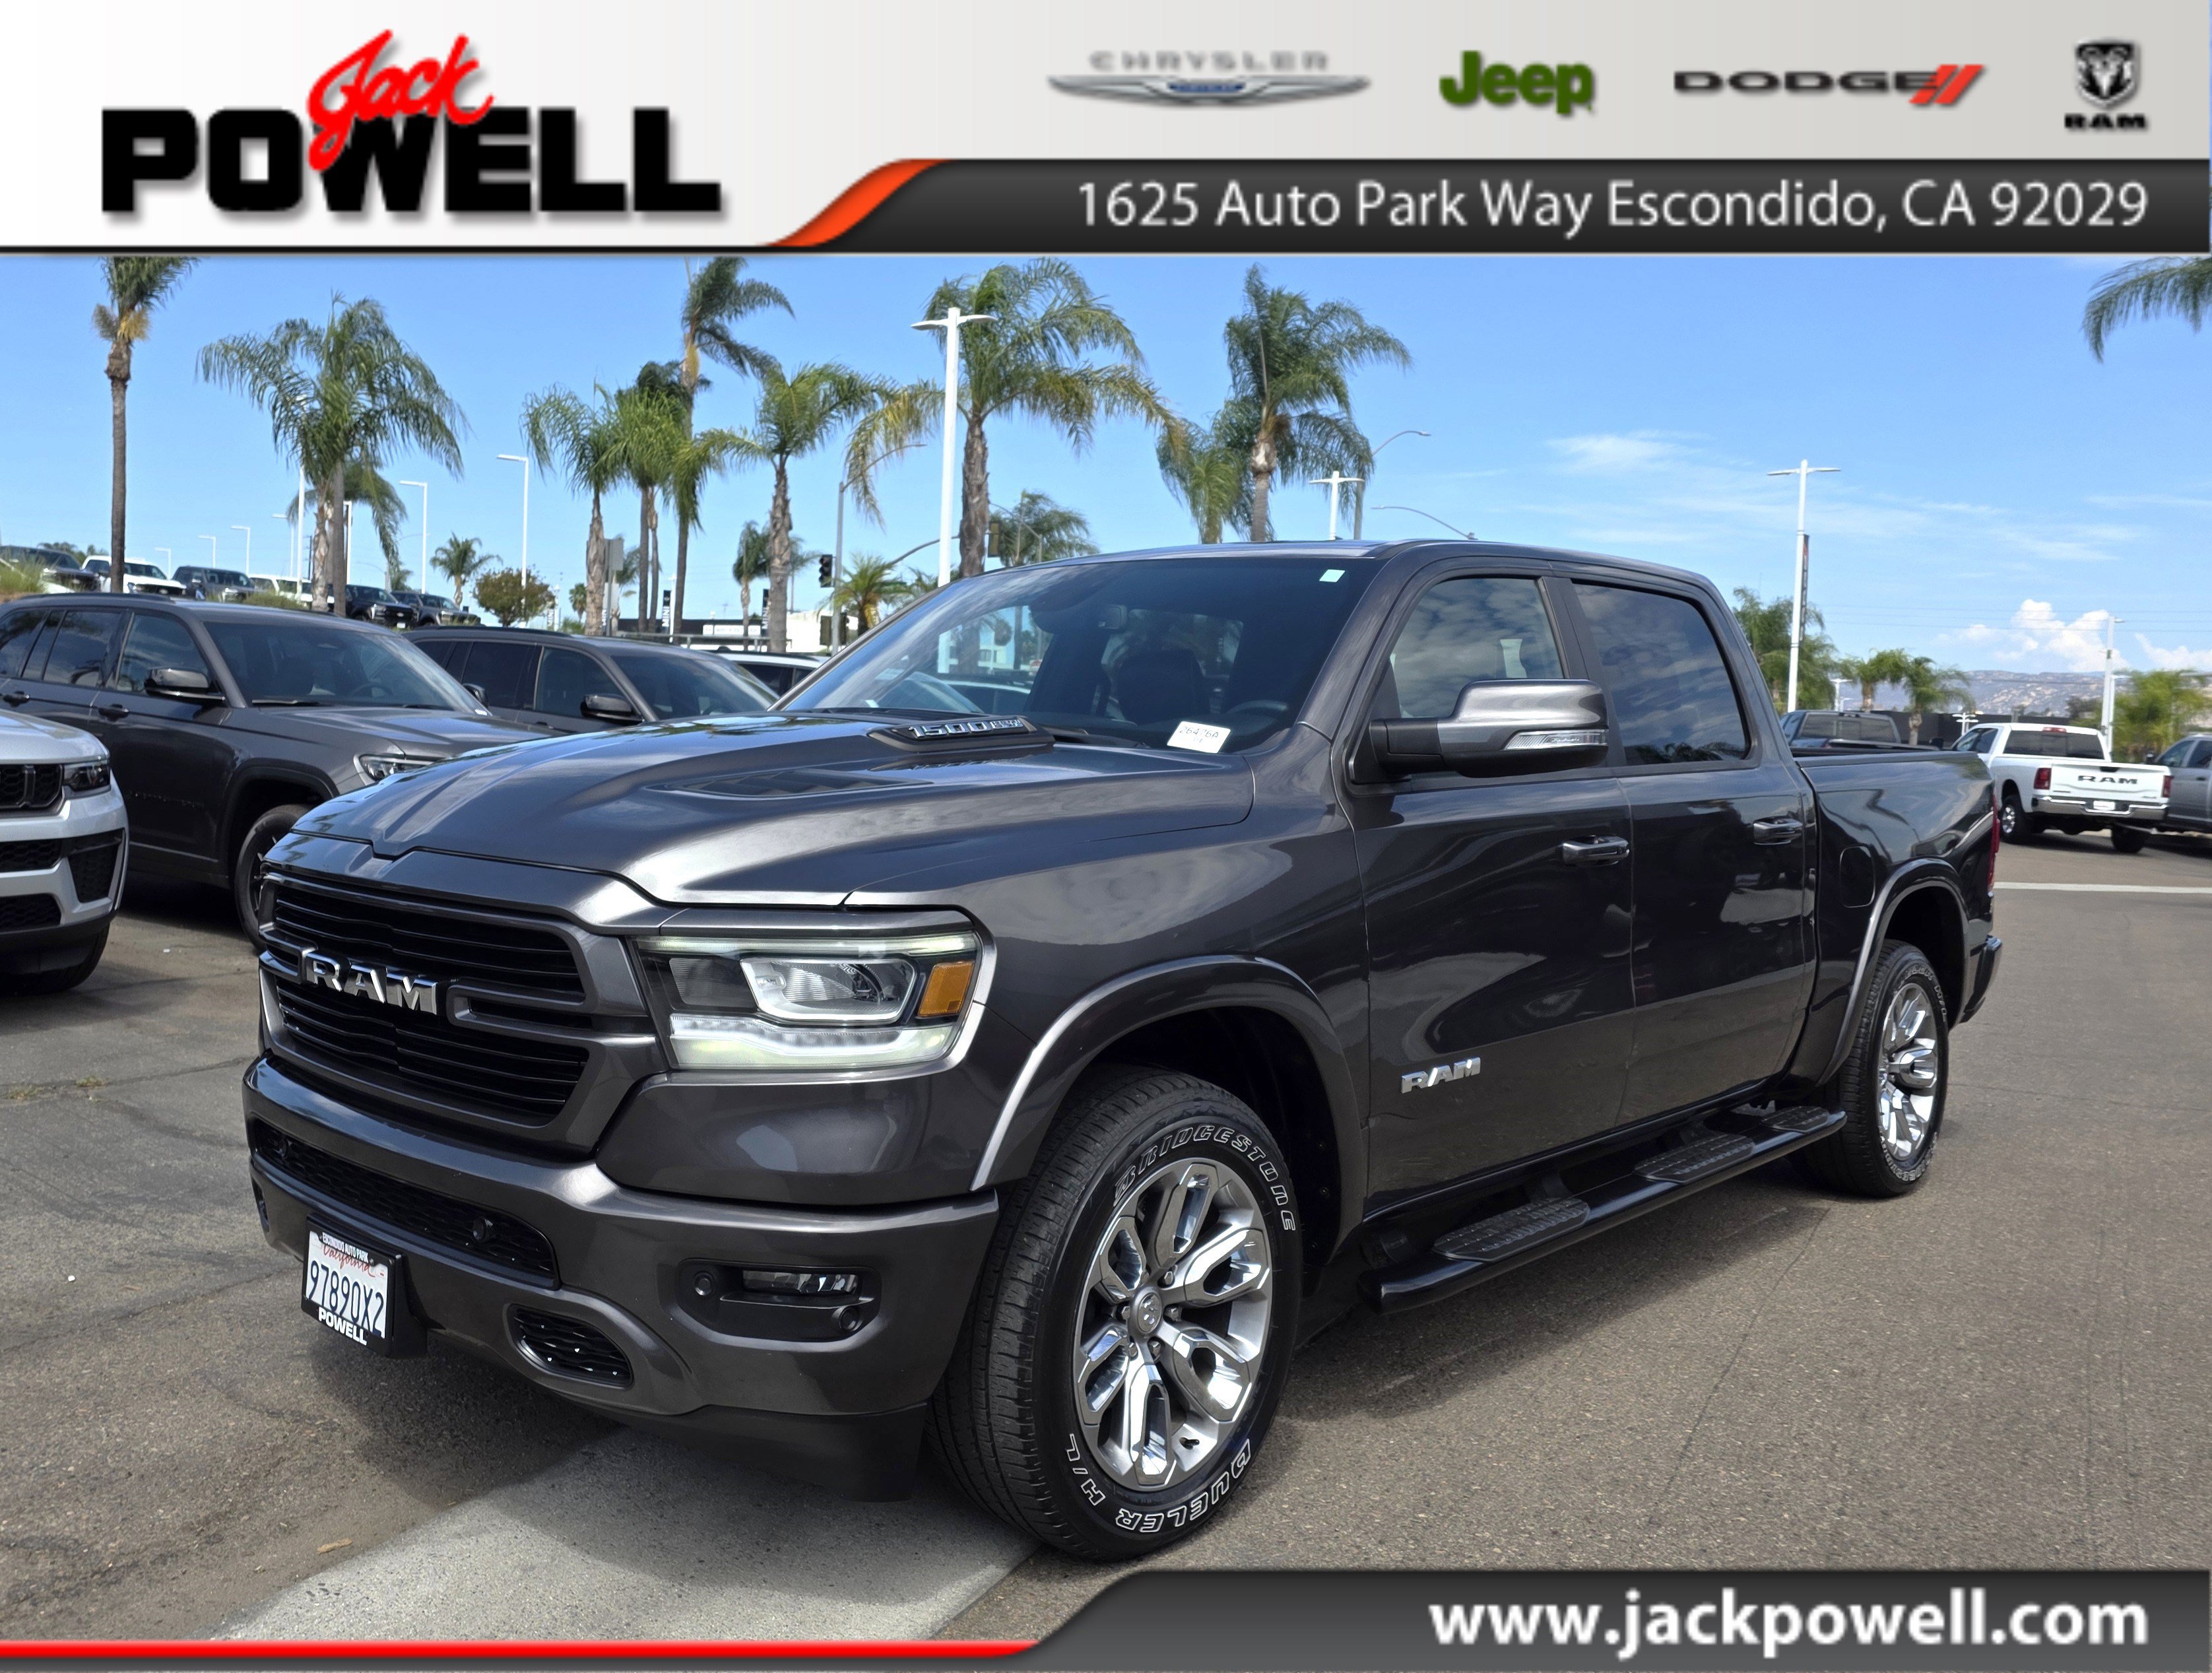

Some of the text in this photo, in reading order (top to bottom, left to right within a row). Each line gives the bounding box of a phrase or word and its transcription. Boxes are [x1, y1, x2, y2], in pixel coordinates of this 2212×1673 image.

[908, 722, 991, 738] 1500
[2078, 775, 2138, 785] RAM
[301, 950, 438, 1015] RAM
[1401, 1057, 1481, 1094] RAM
[1113, 1125, 1296, 1231] BRIDGESTONE
[344, 1243, 356, 1257] AUTO
[356, 1247, 369, 1263] PARK
[309, 1260, 385, 1336] 97890X2
[318, 1307, 368, 1346] POWELL
[1066, 1433, 1251, 1533] DUELER H/L
